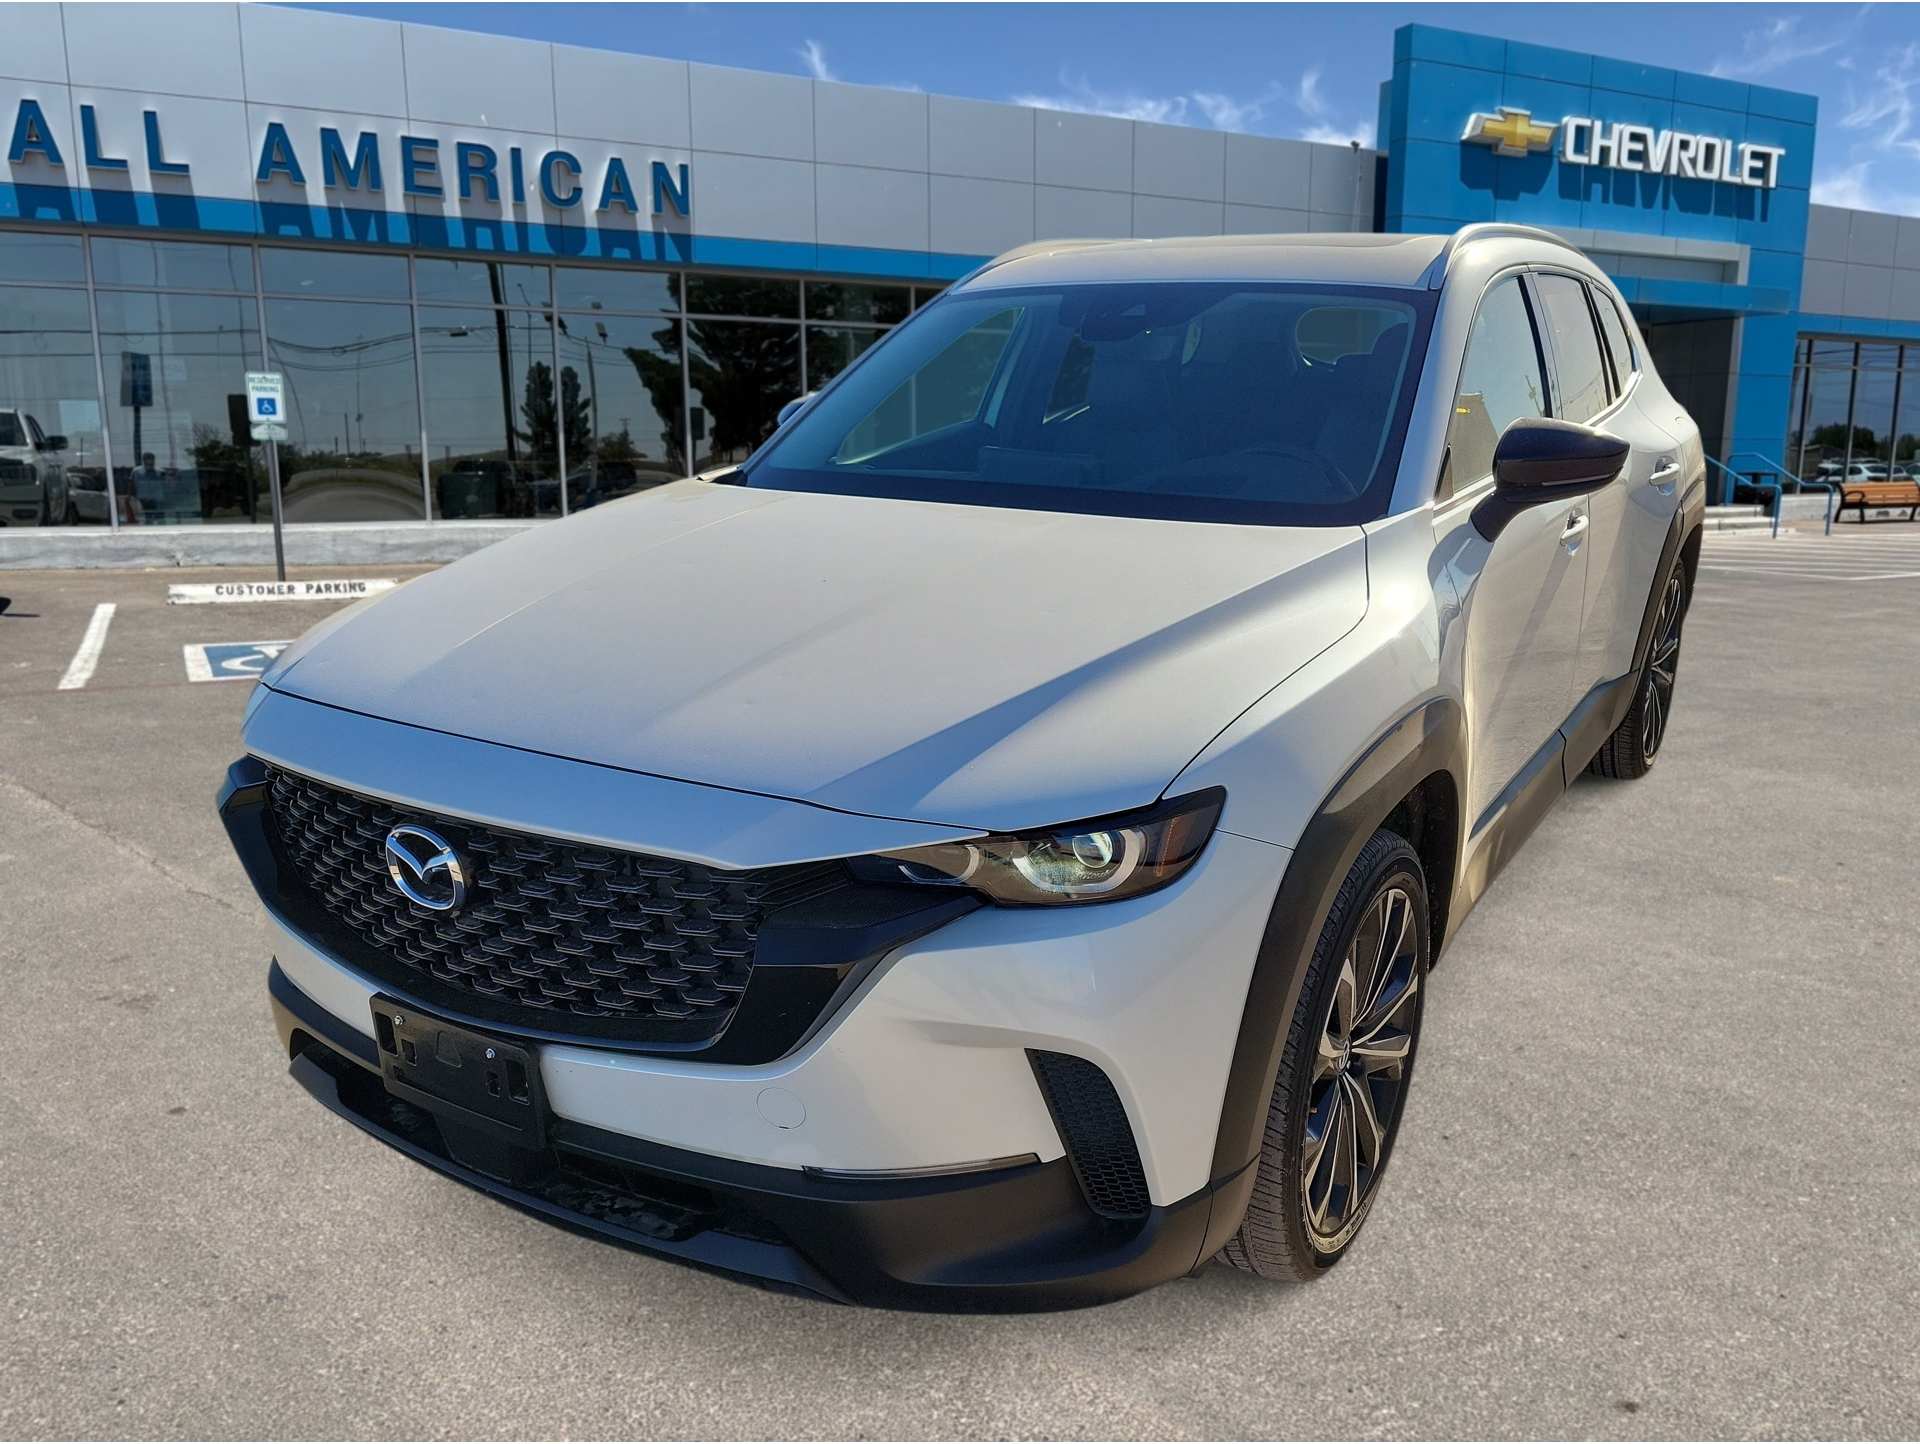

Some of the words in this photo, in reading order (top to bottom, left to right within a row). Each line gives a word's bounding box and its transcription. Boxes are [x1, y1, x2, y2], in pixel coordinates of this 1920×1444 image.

[8, 98, 190, 174] ALL
[256, 121, 691, 216] AMERICAN
[1560, 115, 1785, 188] CHEVROLET
[215, 584, 295, 596] CUSTOMER
[305, 582, 366, 594] PARKING
